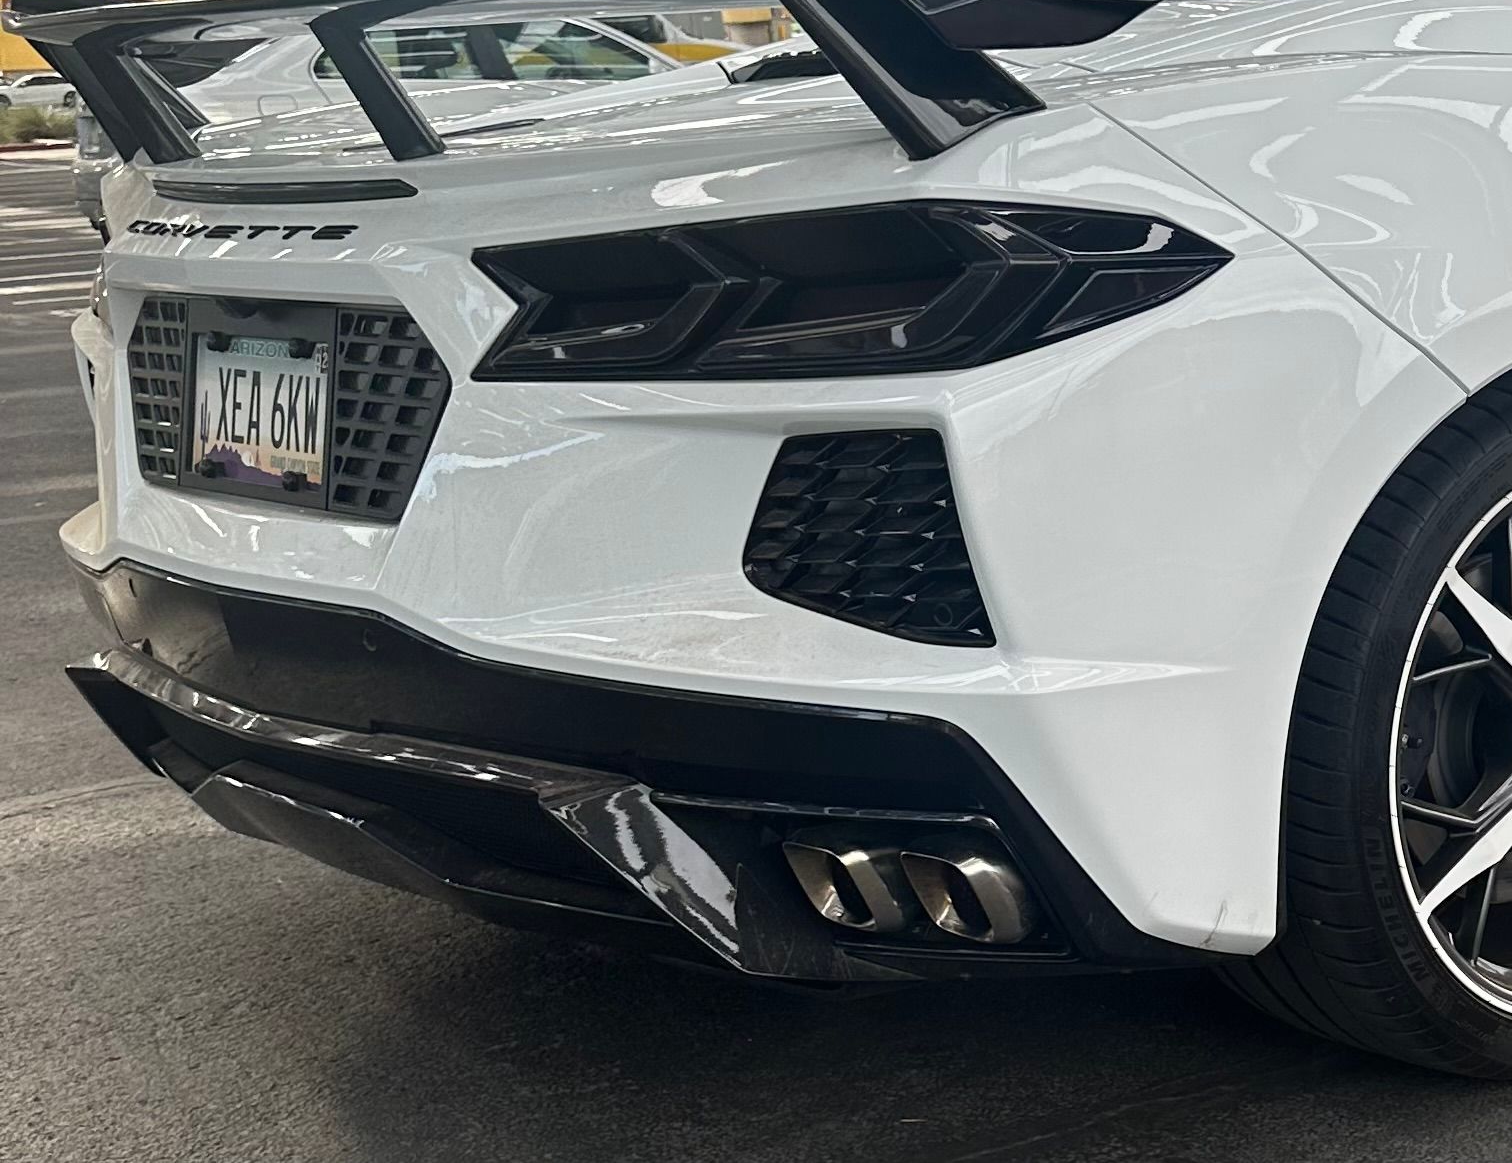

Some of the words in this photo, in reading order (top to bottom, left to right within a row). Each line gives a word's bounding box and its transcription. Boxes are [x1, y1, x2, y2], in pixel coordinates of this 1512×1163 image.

[127, 220, 359, 240] CORVETTE
[230, 339, 290, 357] ARIZON
[216, 366, 263, 446] XEA
[271, 373, 321, 455] 6KW
